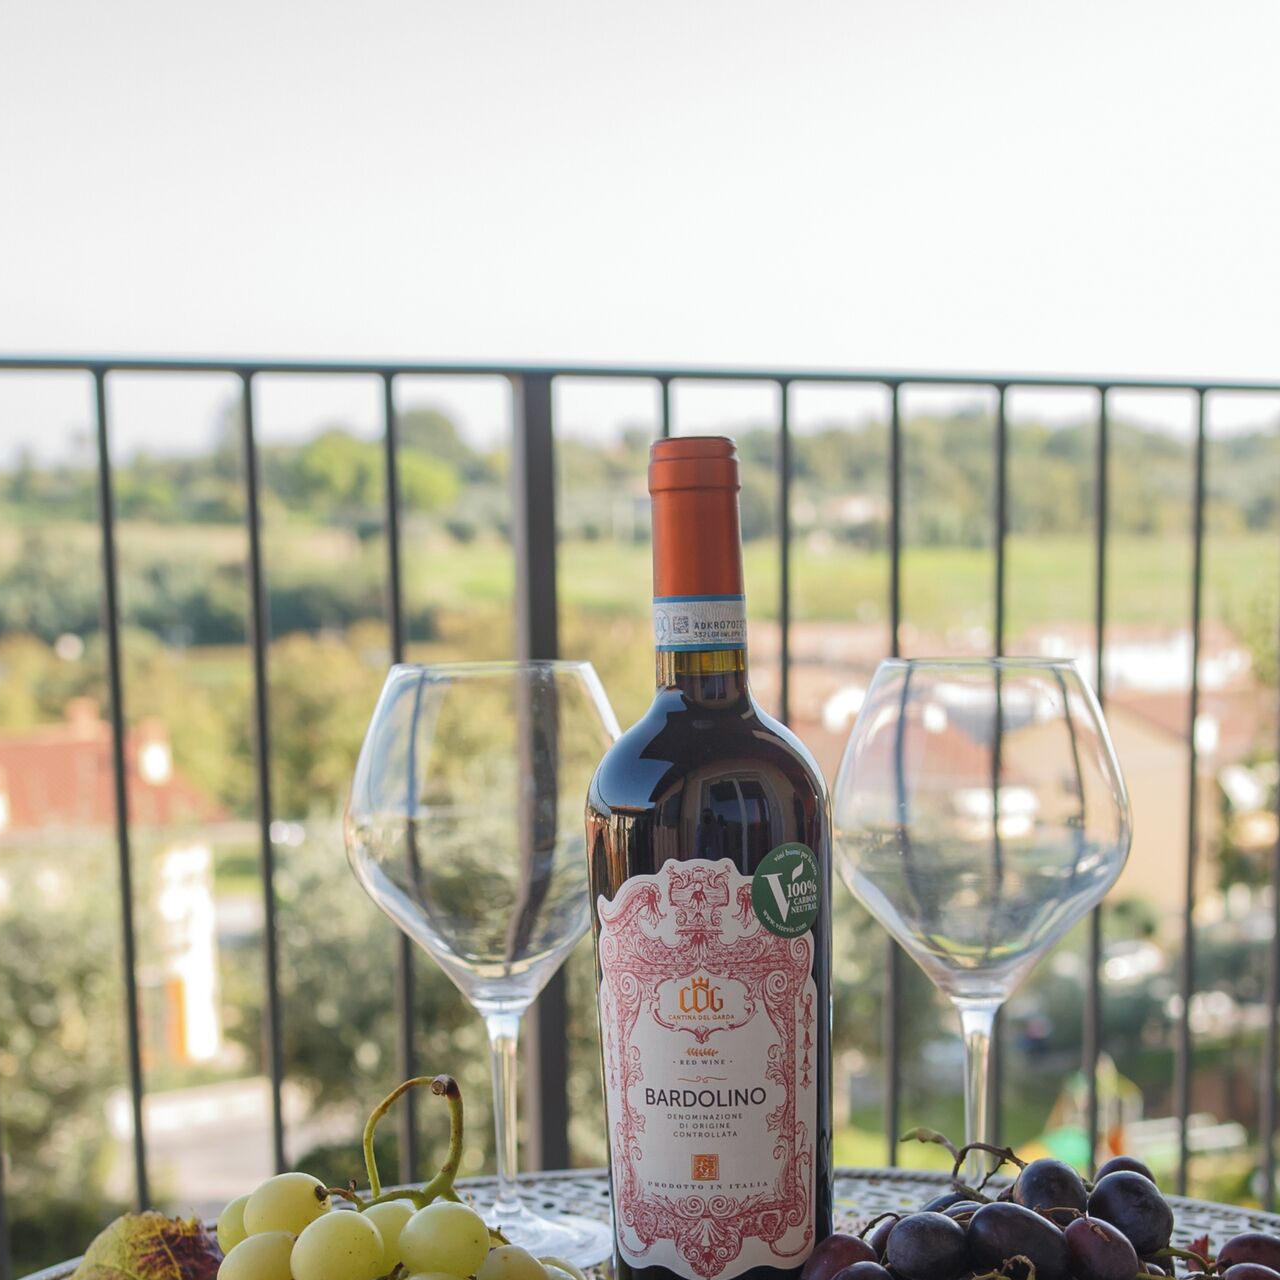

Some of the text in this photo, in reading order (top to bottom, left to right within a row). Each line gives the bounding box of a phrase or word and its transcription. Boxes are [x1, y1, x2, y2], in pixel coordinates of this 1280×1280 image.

[787, 879, 817, 898] 100%
[793, 894, 817, 905] CARBON
[791, 902, 817, 914] NEUTRAL
[645, 1087, 767, 1108] BARDOLINO
[667, 1113, 743, 1121] DENOMINAZIONE
[673, 1130, 738, 1138] CONTROLLATA
[647, 1181, 704, 1190] PRODOTTO
[729, 1181, 769, 1189] ITALIA
